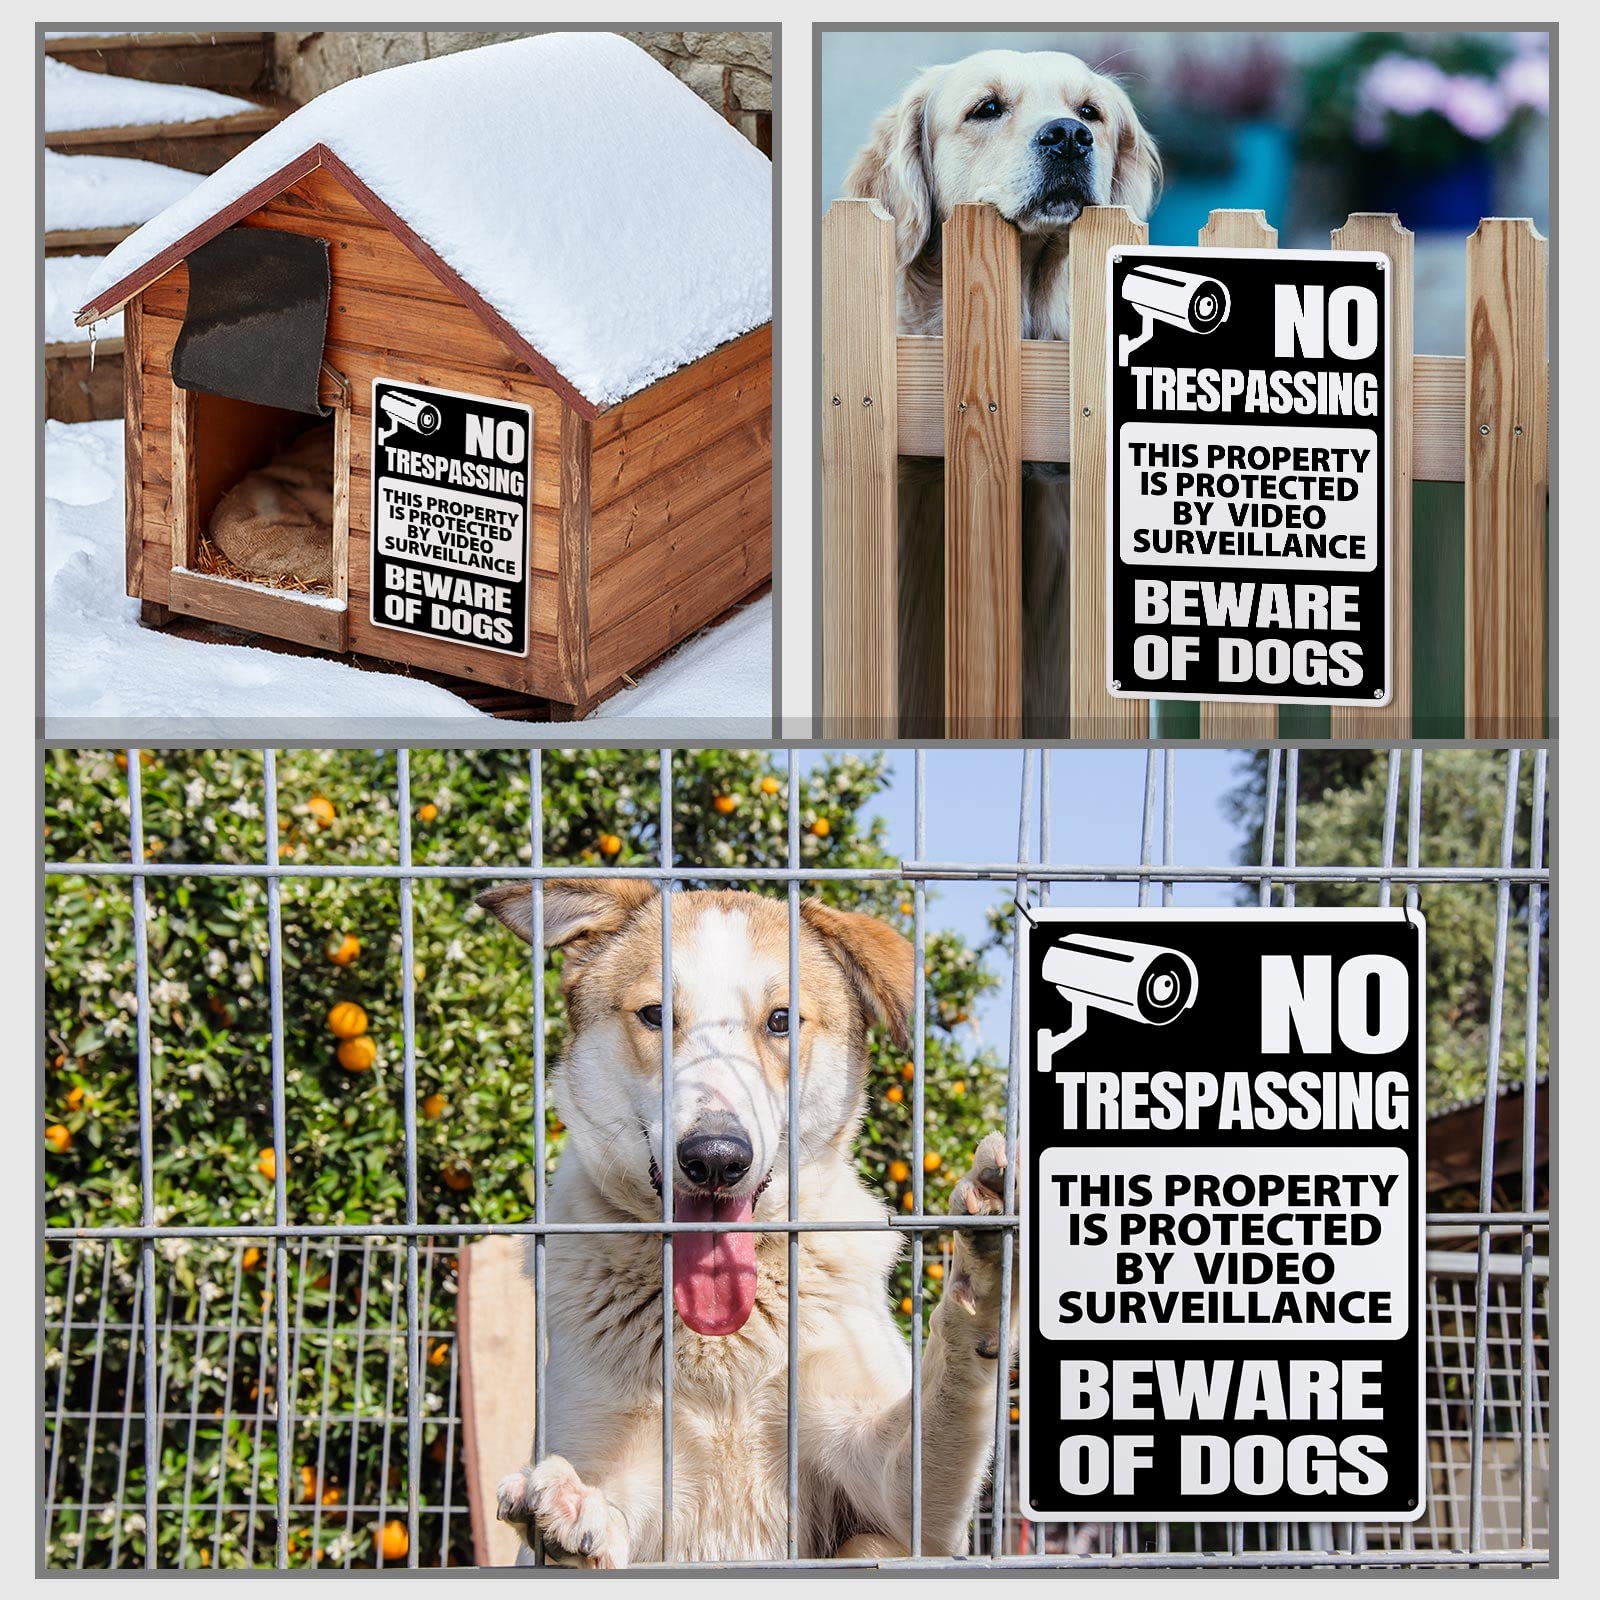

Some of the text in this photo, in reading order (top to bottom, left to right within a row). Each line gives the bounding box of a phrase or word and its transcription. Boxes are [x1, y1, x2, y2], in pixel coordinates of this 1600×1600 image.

[1275, 284, 1378, 361] NO
[1131, 366, 1378, 417] TRESPASSING
[465, 413, 525, 464] NO
[1129, 442, 1370, 473] THIS PROPERTY
[385, 447, 524, 497] TRESPASSING
[1141, 472, 1358, 502] IS PROTECTED
[383, 488, 519, 527] THIS PROPERTY
[390, 505, 512, 542] IS PROTECTED
[1173, 502, 1326, 529] BY VIDEO
[385, 536, 515, 575] SURVEILLANCE
[408, 525, 493, 554] BY VIDEO
[1133, 529, 1366, 560] SURVEILLANCE
[385, 563, 512, 614] BEWARE
[1134, 579, 1360, 631] BEWARE
[384, 595, 513, 644] OF DOGS
[1133, 635, 1364, 687] OF DOGS
[1261, 954, 1409, 1055] NO
[1055, 1071, 1409, 1130] TRESPASSING
[1051, 1174, 1399, 1207] THIS PROPERTY
[1069, 1213, 1381, 1247] IS PROTECTED
[1116, 1252, 1335, 1286] BY VIDEO
[1058, 1290, 1392, 1324] SURVEILLANCE
[1059, 1360, 1383, 1421] BEWARE
[1059, 1434, 1389, 1496] OF DOGS
